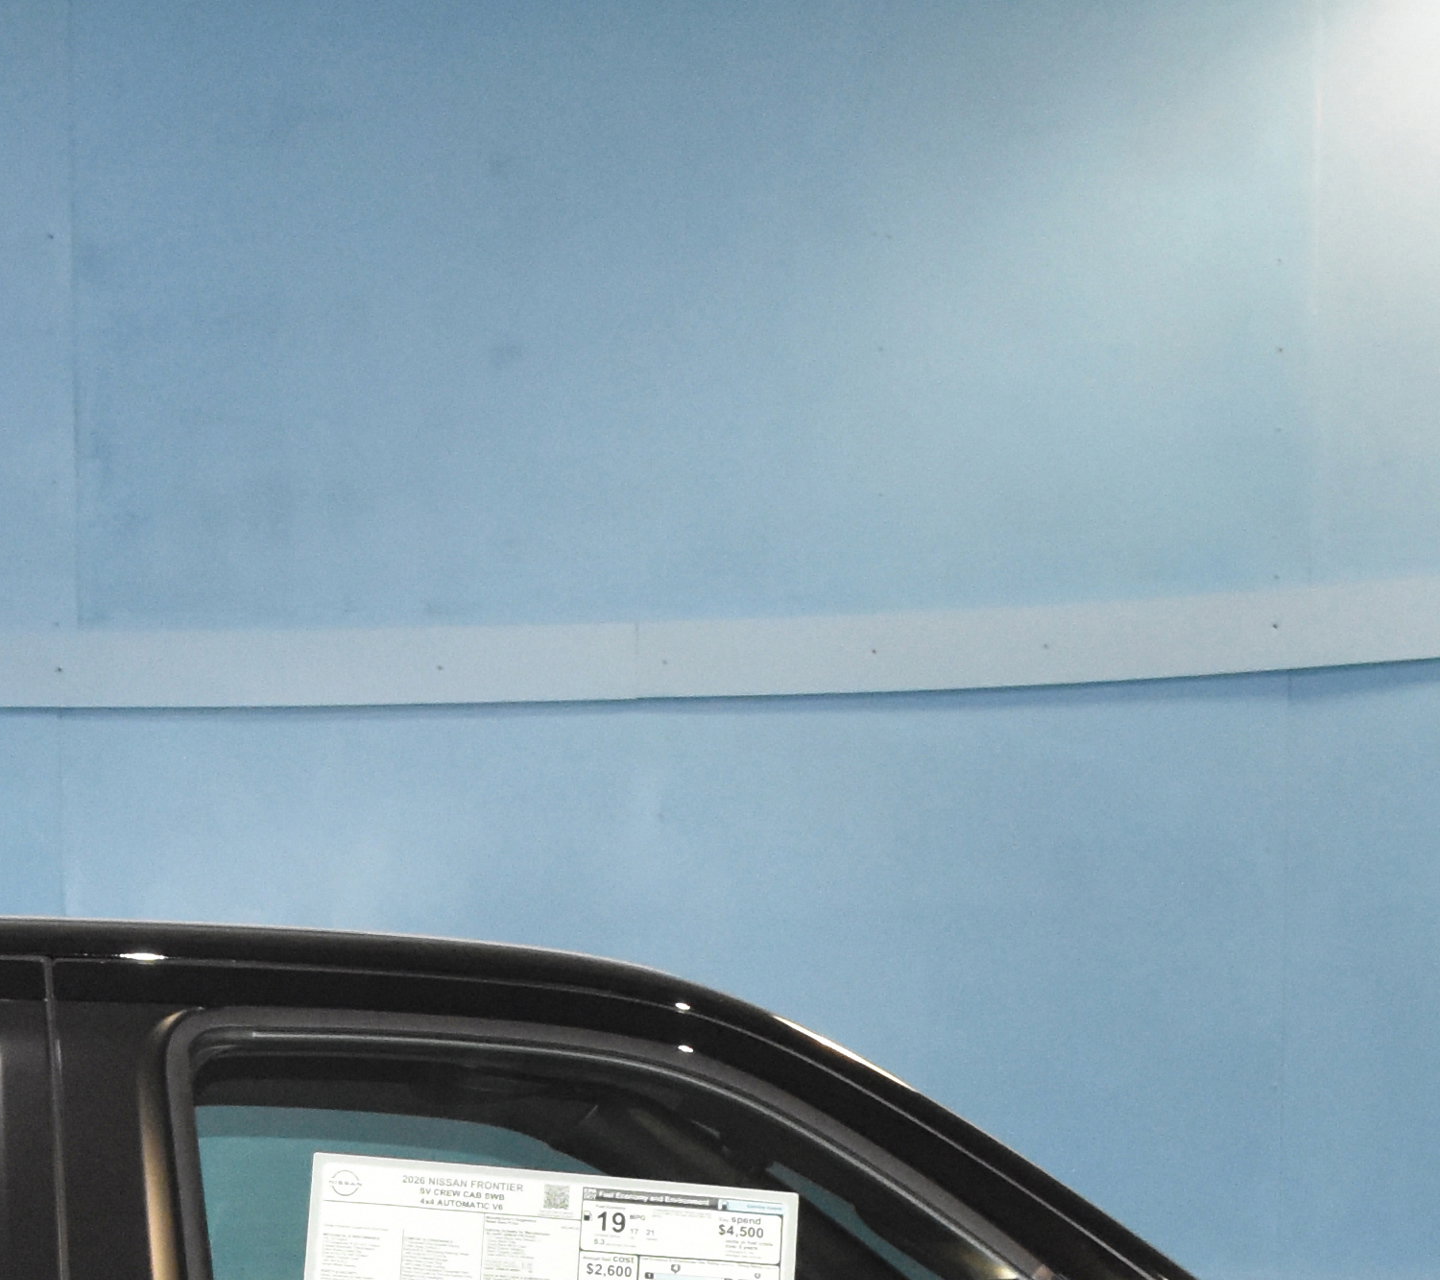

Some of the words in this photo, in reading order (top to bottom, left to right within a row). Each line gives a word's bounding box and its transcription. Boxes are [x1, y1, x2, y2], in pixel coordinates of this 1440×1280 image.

[401, 1174, 426, 1185] 2026
[428, 1176, 468, 1188] NISSAN
[470, 1179, 524, 1192] FRONTIER
[433, 1188, 461, 1197] CREW
[463, 1191, 482, 1199] CAB
[599, 1191, 614, 1200] Fuel
[615, 1191, 649, 1203] Economy
[419, 1198, 435, 1206] 4x4
[437, 1199, 490, 1210] AUTOMATIC
[492, 1203, 504, 1211] V6
[597, 1211, 626, 1234] 19
[731, 1216, 762, 1225] spend
[718, 1223, 764, 1239] $4,500
[613, 1256, 635, 1264] cost
[586, 1262, 632, 1278] $2,600
